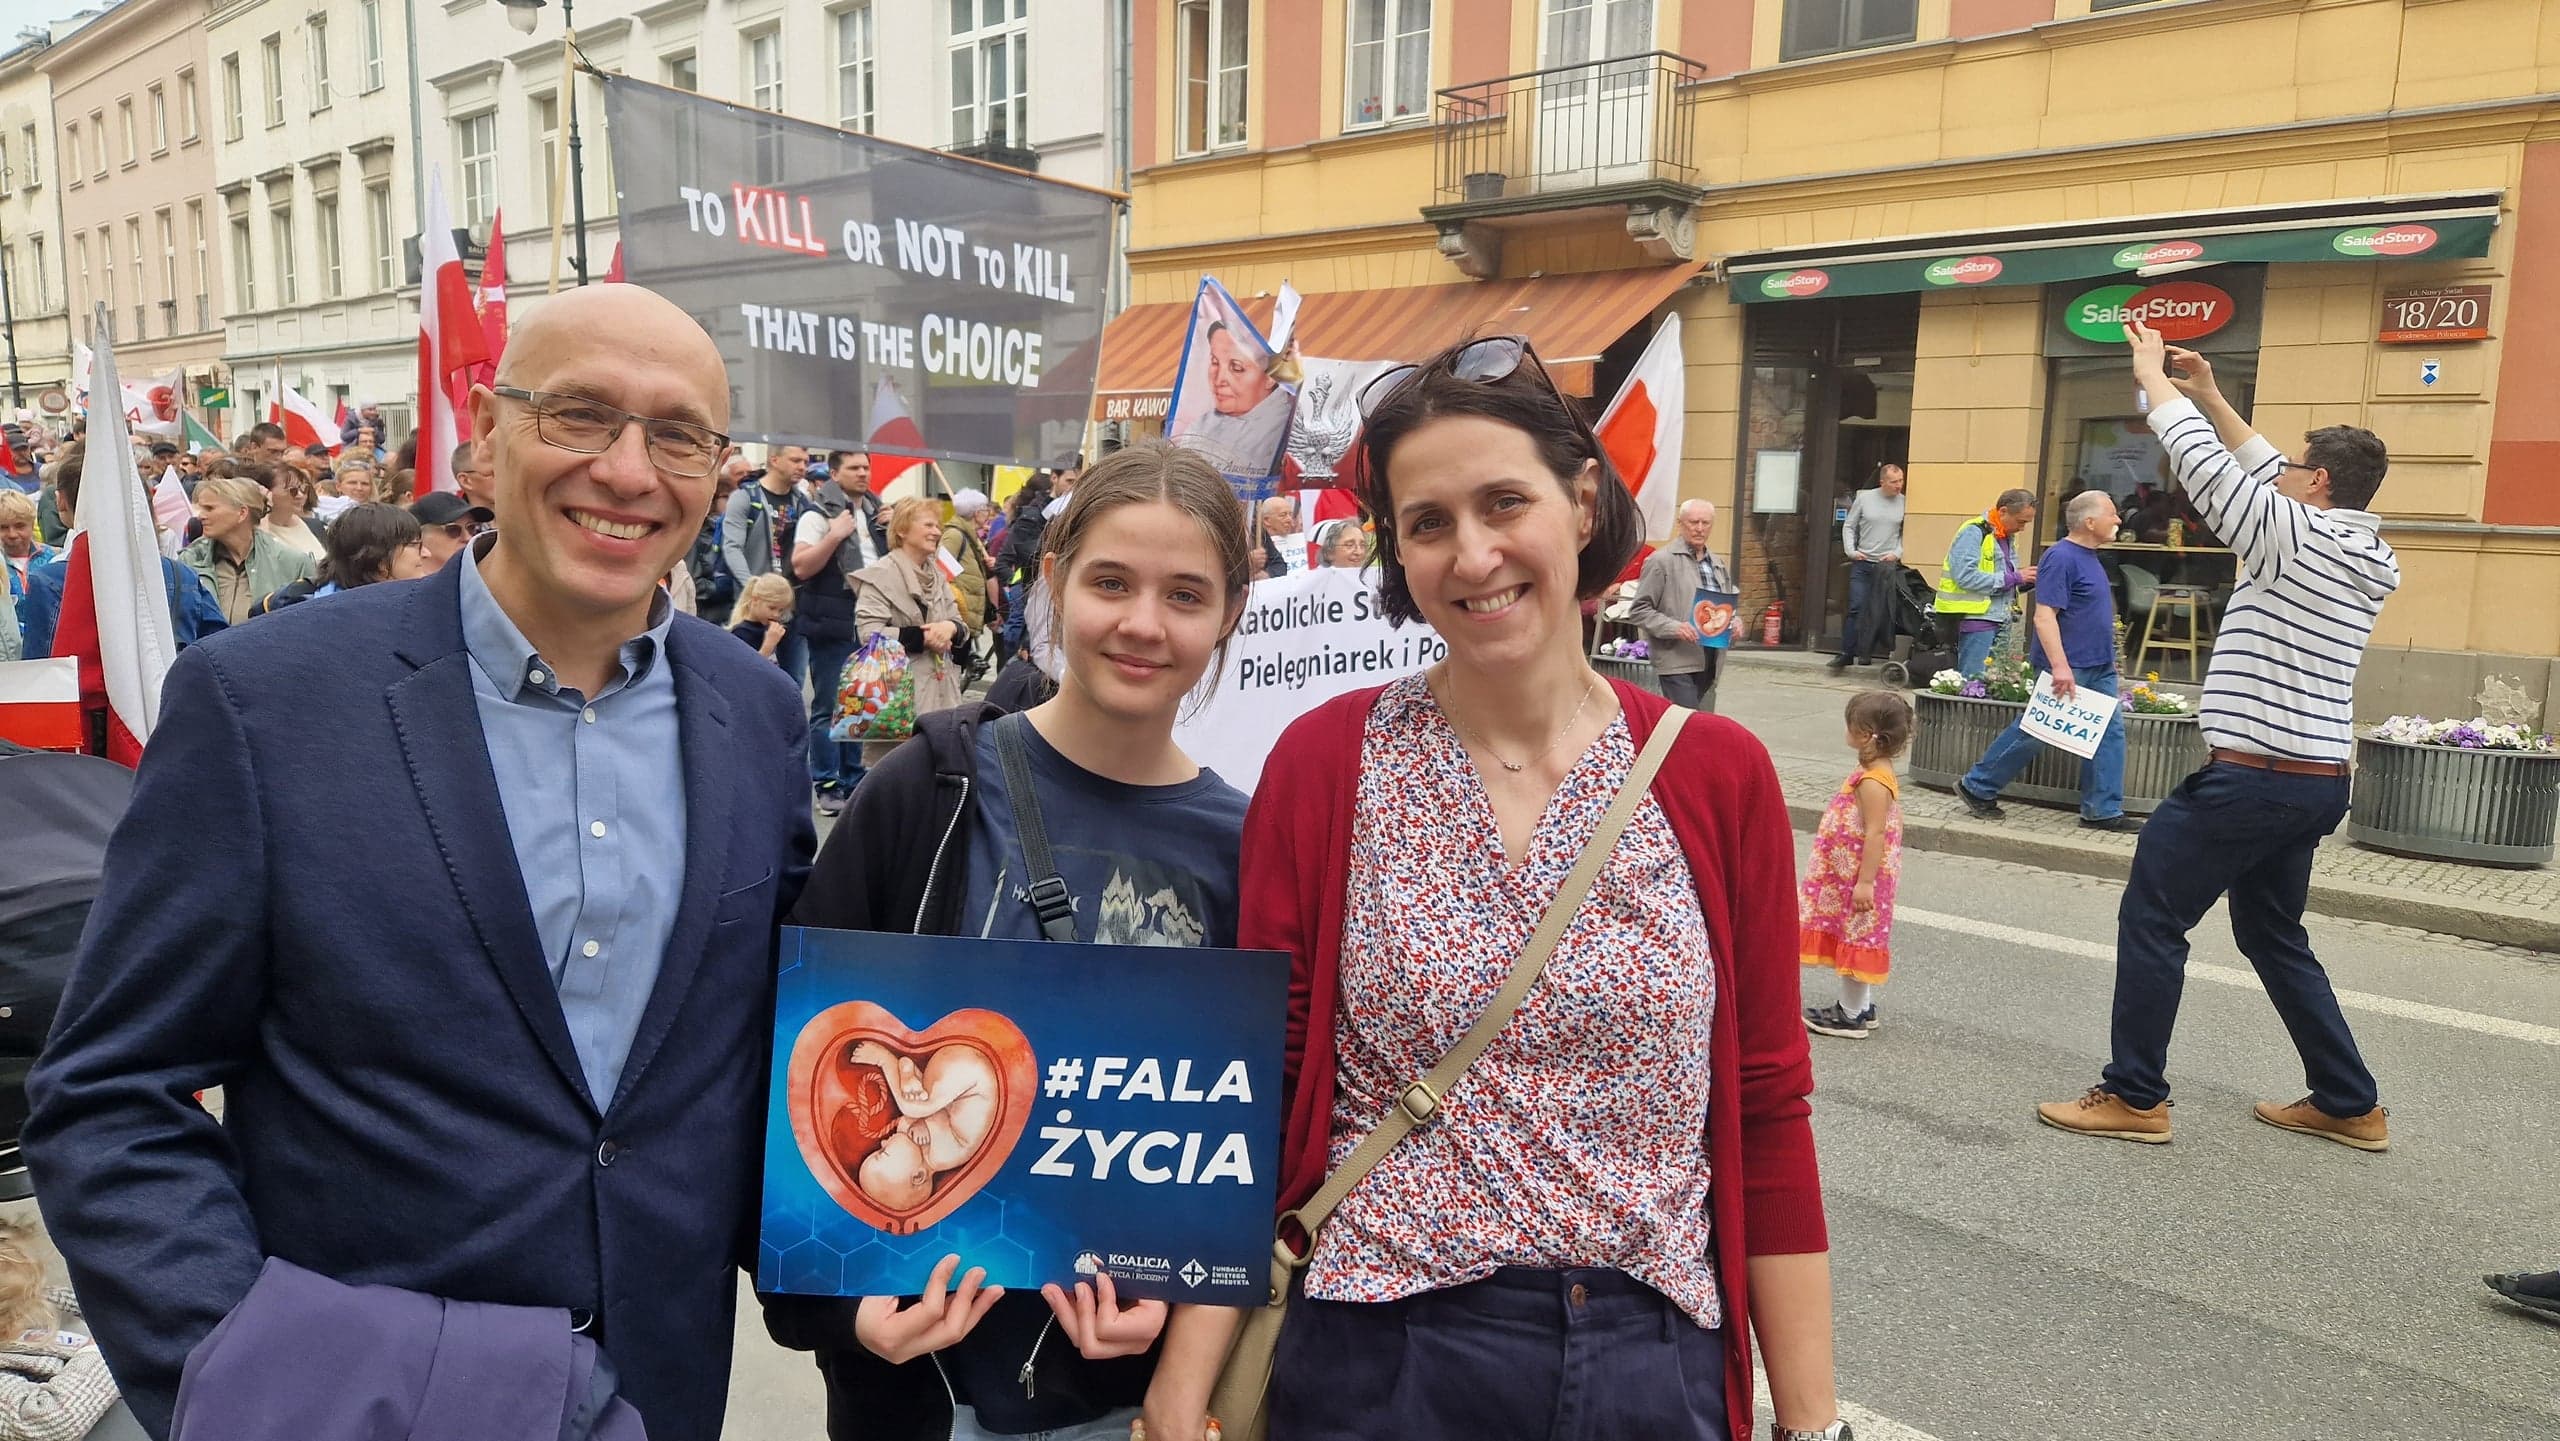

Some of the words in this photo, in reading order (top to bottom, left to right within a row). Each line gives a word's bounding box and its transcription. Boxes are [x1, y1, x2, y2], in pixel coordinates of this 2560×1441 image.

[680, 186, 725, 236] TO
[732, 182, 827, 257] KILL
[843, 220, 884, 266] OR
[896, 218, 965, 280] NOT
[974, 246, 1006, 288] TO
[1014, 242, 1075, 304] KILL
[2342, 231, 2427, 247] SaladStory
[2120, 246, 2194, 262] SaladStory
[1932, 262, 1995, 276] SaladStory
[1767, 275, 1822, 289] SaladStory
[2081, 298, 2216, 321] SaladStory
[2394, 297, 2478, 329] 18/20
[741, 303, 819, 355] THAT
[828, 316, 855, 361] IS
[861, 321, 914, 369] THE
[921, 313, 1042, 388] CHOICE
[1106, 399, 1130, 418] BAR
[1354, 591, 1382, 622] St
[1240, 639, 1394, 691] Pielęgniarek
[1403, 638, 1410, 667] i
[1418, 637, 1447, 665] Po
[2035, 692, 2064, 709] NIECH
[2067, 703, 2104, 725] ŻYJE
[2028, 707, 2098, 742] POLSKA!
[1044, 1057, 1253, 1103] #FALA
[1029, 1109, 1254, 1185] ŻYCIA
[1108, 1254, 1171, 1270] KOALICJA
[1212, 1265, 1247, 1273] FUNDACJA
[1135, 1272, 1170, 1283] RODZINY
[1211, 1278, 1250, 1286] BENEDYKTA
